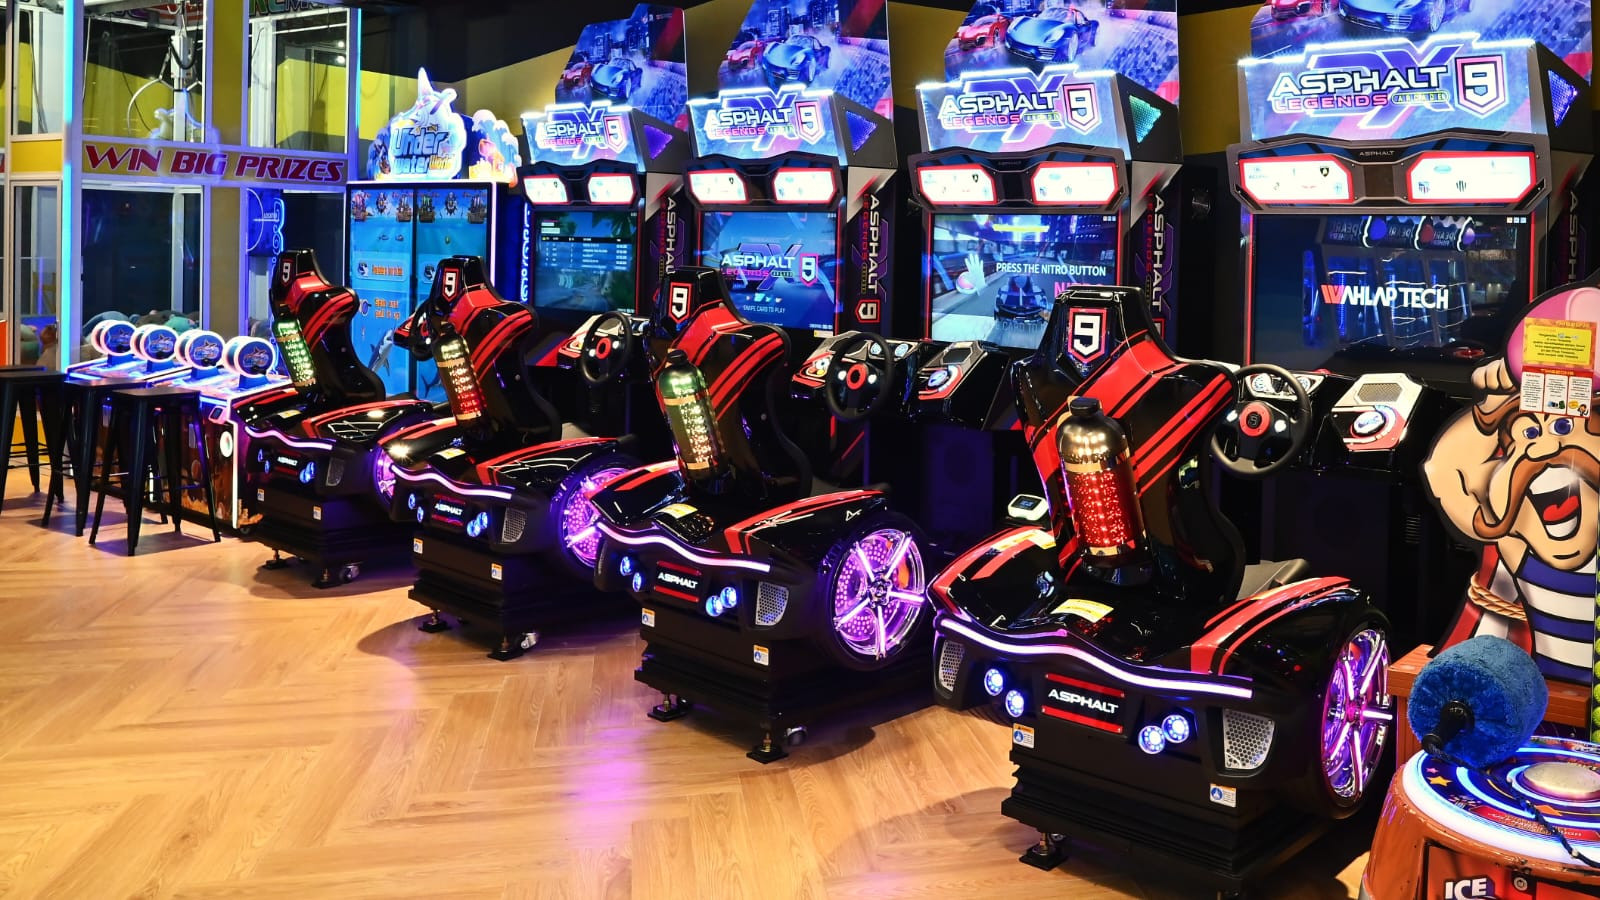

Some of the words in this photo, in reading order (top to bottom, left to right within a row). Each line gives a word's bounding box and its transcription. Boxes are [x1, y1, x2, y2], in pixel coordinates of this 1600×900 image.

[1273, 66, 1447, 97] ASPHALT
[942, 91, 1059, 116] ASPHALT
[1069, 87, 1094, 117] 9
[1275, 95, 1388, 111] LEGENDS
[1397, 92, 1445, 102] ARCADE
[607, 119, 623, 145] 9
[704, 107, 792, 129] ASPHALT
[800, 106, 818, 135] 9
[943, 113, 1021, 127] LEGENDS
[393, 127, 449, 156] Under
[85, 145, 162, 172] WIN
[170, 151, 228, 176] BIG
[235, 155, 345, 182] PRIZES
[665, 197, 677, 275] ASPHAL
[868, 194, 880, 294] ASPHALT
[1568, 191, 1578, 280] ASPH
[1152, 194, 1164, 312] ASPHALT
[281, 261, 292, 284] 9
[721, 254, 796, 269] ASPHALT
[802, 257, 816, 282] 9
[996, 262, 1023, 273] PRESS
[1024, 263, 1039, 274] THE
[1041, 264, 1068, 275] NITRO
[1069, 265, 1106, 276] BUTTON
[445, 272, 457, 297] 9
[1399, 286, 1449, 309] TECH
[671, 286, 689, 321] 9
[1073, 314, 1102, 355] 9
[657, 571, 698, 589] ASPHALT
[1048, 688, 1119, 714] ASPHALT
[1445, 877, 1488, 900] ICE
